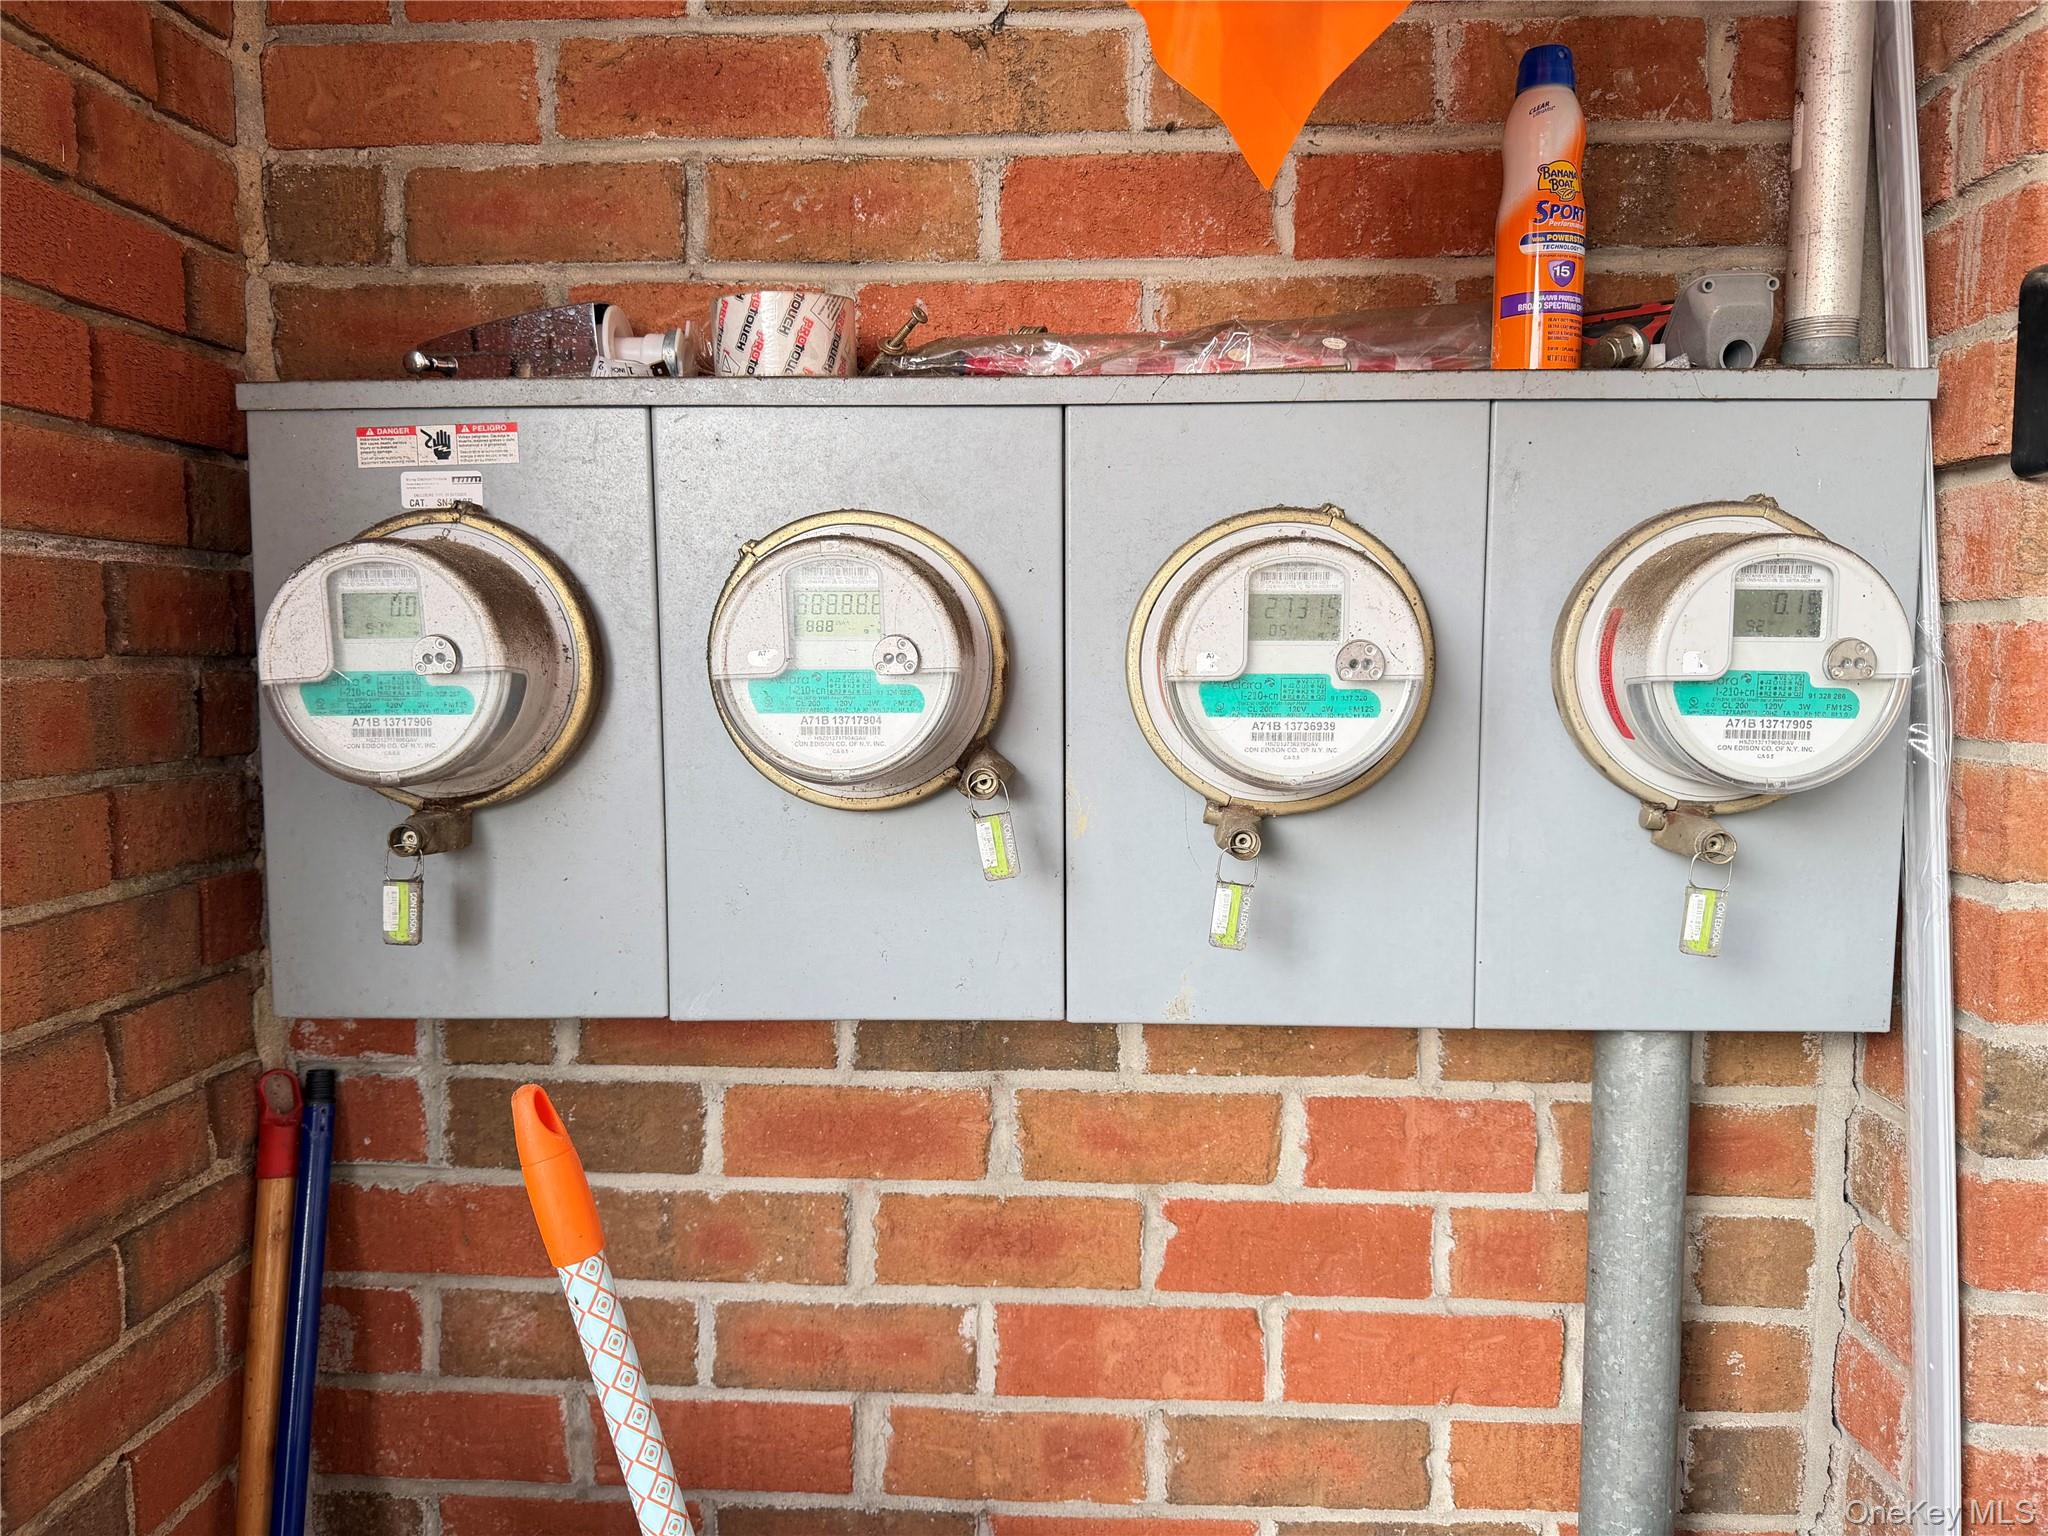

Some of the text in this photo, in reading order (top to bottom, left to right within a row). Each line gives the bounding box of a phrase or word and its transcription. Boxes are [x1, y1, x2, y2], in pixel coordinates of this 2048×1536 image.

[1529, 101, 1550, 115] CLEAR
[1532, 200, 1585, 224] SPORT
[1553, 265, 1571, 277] 15
[376, 427, 410, 435] DANGER
[472, 423, 507, 432] PELIGRO
[1764, 702, 1784, 710] 120V
[1798, 703, 1812, 711] 3W
[1825, 703, 1853, 711] FM12S
[352, 717, 433, 727] A71B 13717906
[800, 715, 882, 725] A71B 13717904
[1725, 718, 1813, 730] A71B 13717905
[1251, 721, 1336, 731] A71B 13736939
